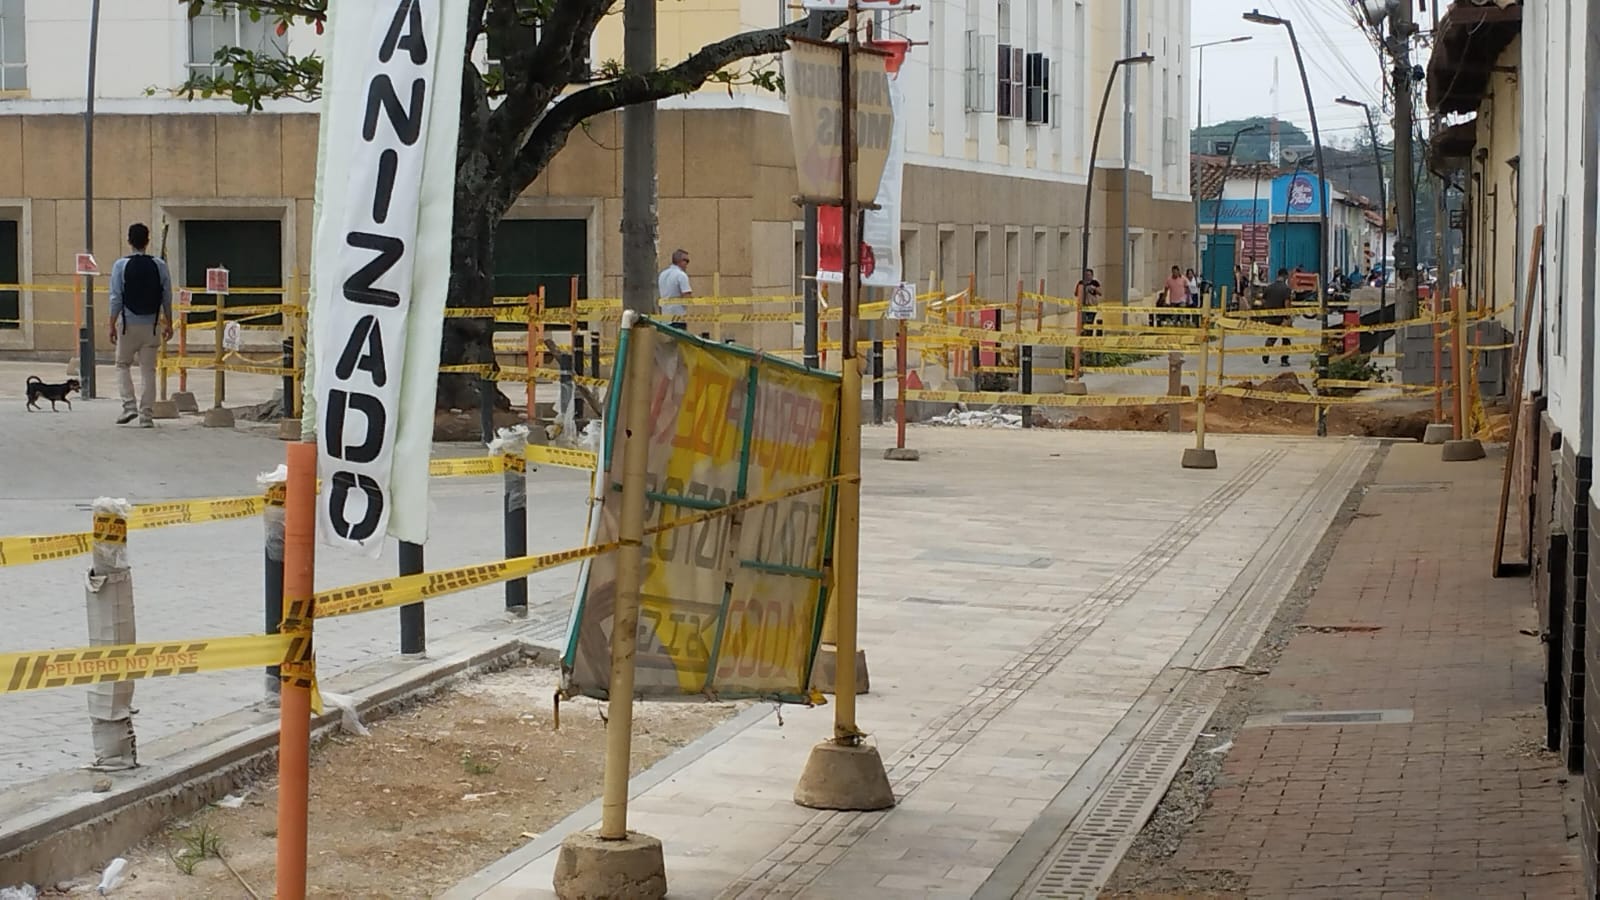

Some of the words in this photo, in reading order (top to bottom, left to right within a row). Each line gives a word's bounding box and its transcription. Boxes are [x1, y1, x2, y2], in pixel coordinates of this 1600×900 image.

[325, 0, 428, 541] ANIZADO
[45, 659, 119, 677] PELIGRO
[125, 658, 149, 669] NO
[157, 653, 198, 667] PASE
